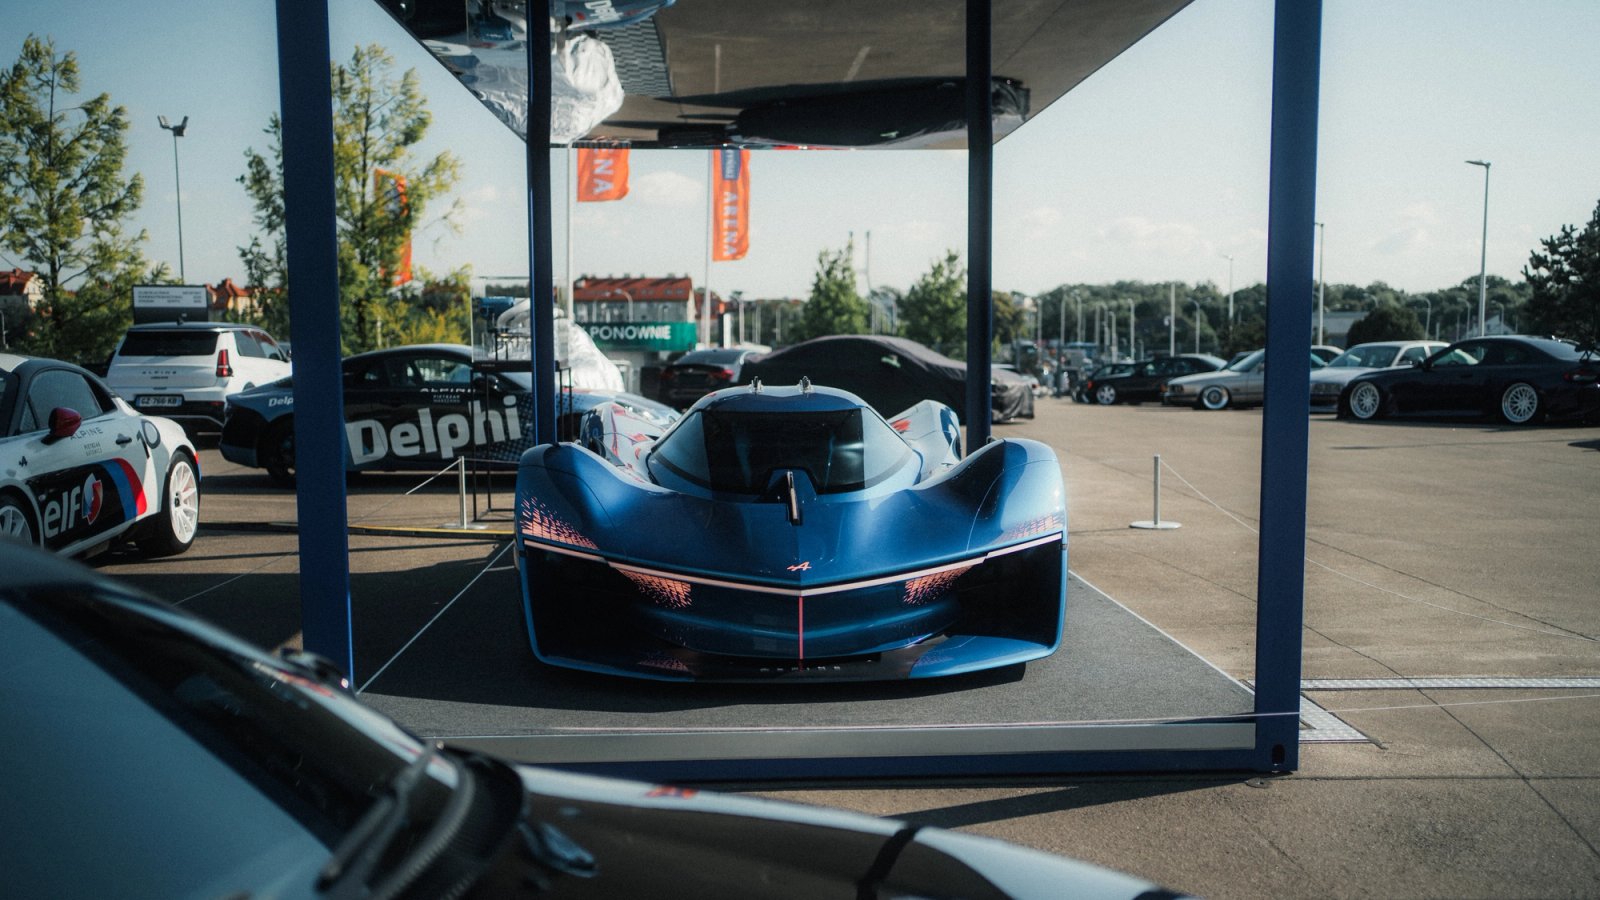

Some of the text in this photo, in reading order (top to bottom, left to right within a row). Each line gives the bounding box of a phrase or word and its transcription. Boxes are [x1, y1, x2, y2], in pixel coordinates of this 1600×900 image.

[723, 191, 738, 257] ARENA
[589, 324, 671, 340] PONOWNIE
[70, 426, 103, 441] ALPINE
[345, 395, 522, 466] Delphi
[43, 485, 81, 539] elf
